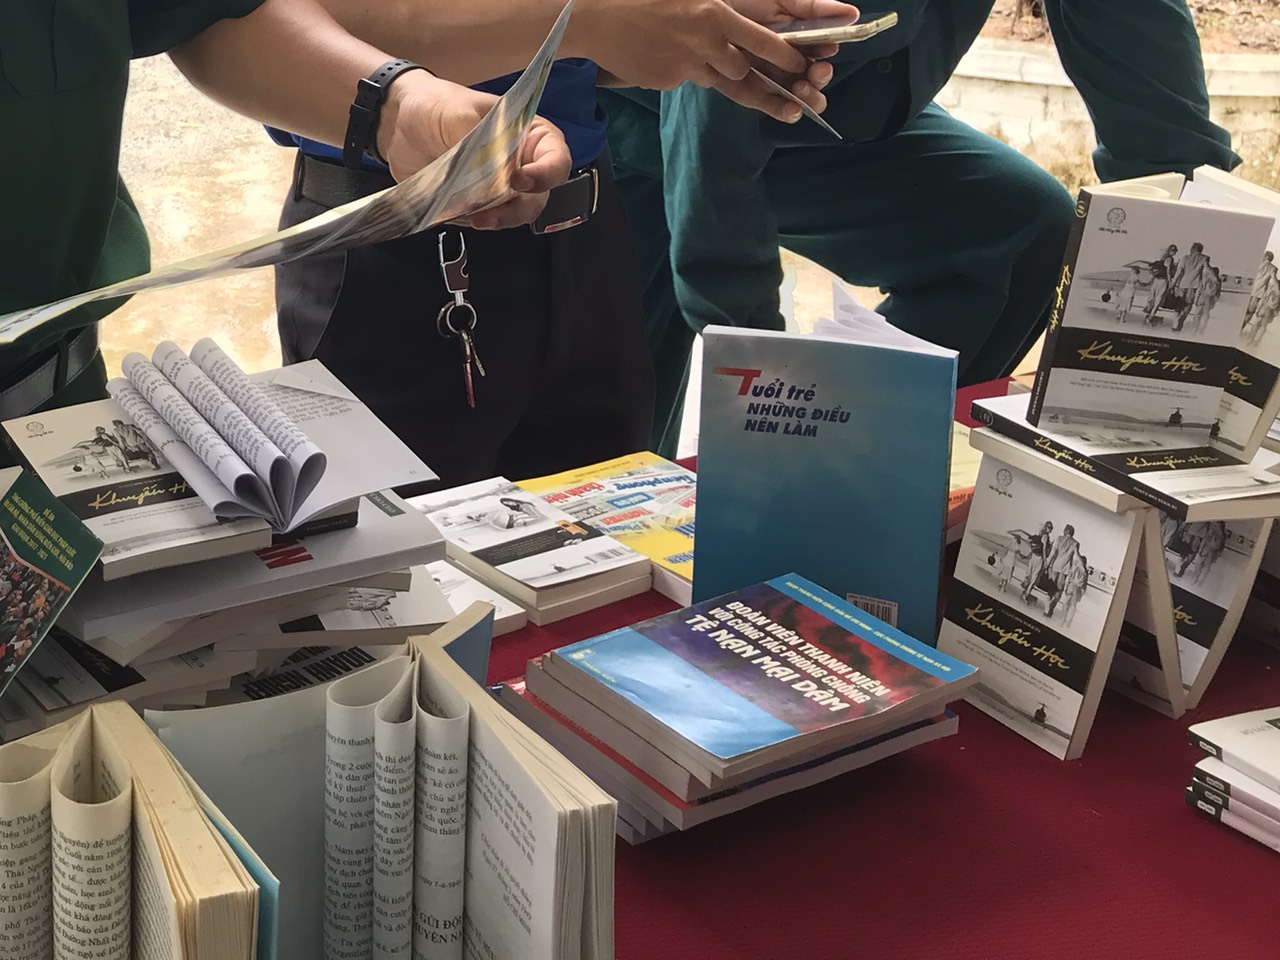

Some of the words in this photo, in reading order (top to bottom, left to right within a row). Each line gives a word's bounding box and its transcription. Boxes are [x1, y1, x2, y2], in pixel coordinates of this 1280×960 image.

[1077, 339, 1159, 374] Khuyến
[1162, 355, 1207, 374] Học
[712, 366, 786, 399] Tuổi
[786, 381, 816, 402] trẻ
[743, 415, 779, 434] NÊN
[782, 418, 818, 437] LÀM
[746, 398, 807, 419] NHỮNG
[810, 403, 851, 424] ĐIỀU
[87, 475, 179, 511] Khuyến
[707, 607, 736, 621] VỚI
[726, 617, 766, 638] CÔNG
[757, 635, 790, 652] TÁC
[778, 649, 826, 674] PHÒNG
[818, 672, 872, 701] CHỐNG
[724, 599, 772, 625] ĐOÀN
[764, 623, 806, 645] VIÊN
[797, 644, 851, 673] THANH
[843, 671, 892, 696] NIÊN
[965, 604, 1031, 648] Khuyến
[1032, 644, 1070, 670] Học
[301, 645, 377, 682] DOANH
[681, 615, 721, 633] TỆ
[706, 630, 759, 658] NẠN
[748, 656, 800, 682] MẠI
[788, 678, 853, 712] DÂM
[73, 910, 90, 921] khá
[74, 900, 96, 912] động
[76, 923, 91, 934] báo
